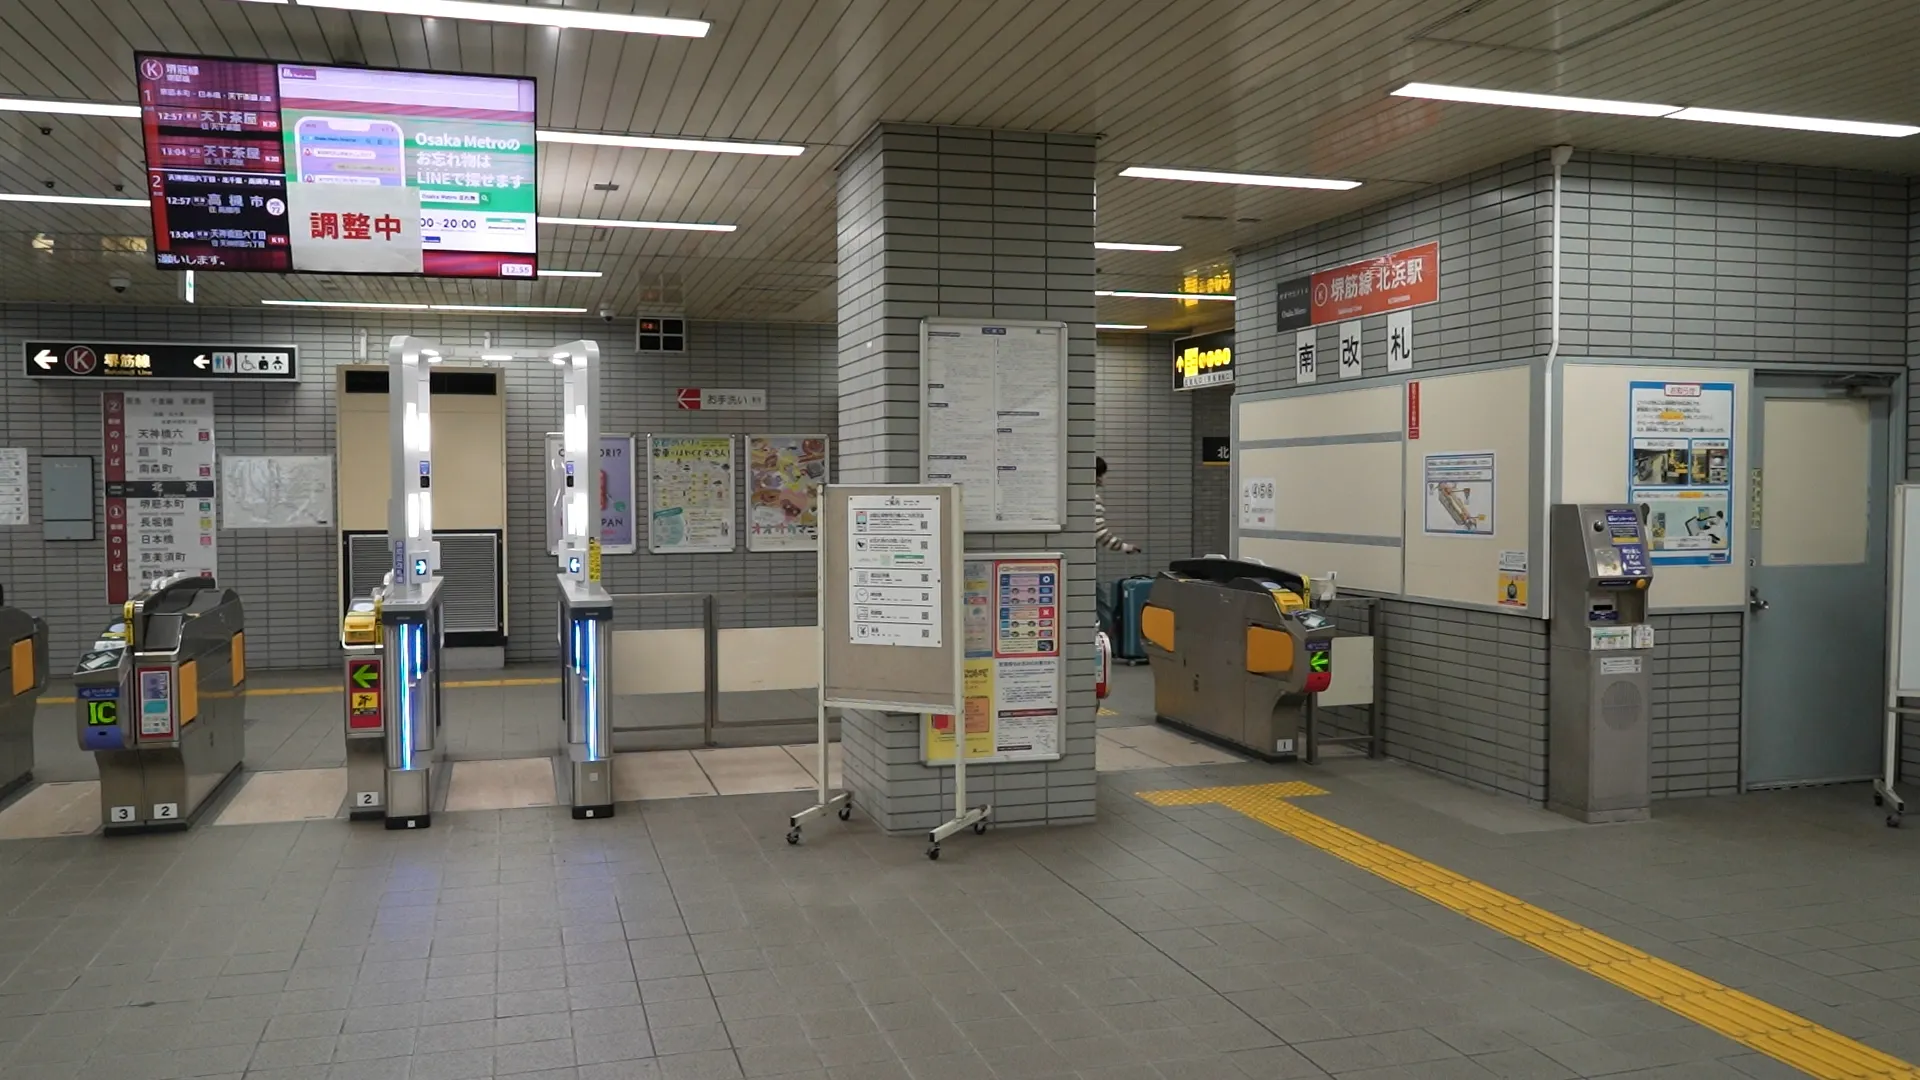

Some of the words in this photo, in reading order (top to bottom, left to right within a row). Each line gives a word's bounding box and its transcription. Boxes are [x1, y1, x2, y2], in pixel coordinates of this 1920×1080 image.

[144, 90, 151, 102] 1
[200, 110, 257, 125] 天下茶屋
[415, 132, 462, 148] Osaka
[463, 134, 521, 151] Metroの
[203, 145, 260, 160] 天下茶屋
[416, 152, 493, 169] お忘れ物は
[152, 175, 161, 188] 2
[416, 171, 525, 190] LINEで探せます
[166, 197, 191, 205] 12:57
[309, 211, 402, 242] 調整中
[504, 266, 530, 275] 12:55
[1330, 270, 1373, 302] 堺筋線
[1376, 257, 1423, 292] 北浜駅
[1298, 326, 1411, 375] 南改札
[73, 350, 89, 370] K
[103, 353, 151, 369] 堺筋線
[707, 394, 748, 405] お手洗い
[138, 428, 184, 440] 天神橋六
[141, 534, 174, 545] 日本橋
[141, 552, 187, 563] 恵美須町
[89, 701, 117, 724] IC
[363, 793, 373, 805] 2
[118, 809, 129, 820] 3
[161, 806, 171, 817] 2
